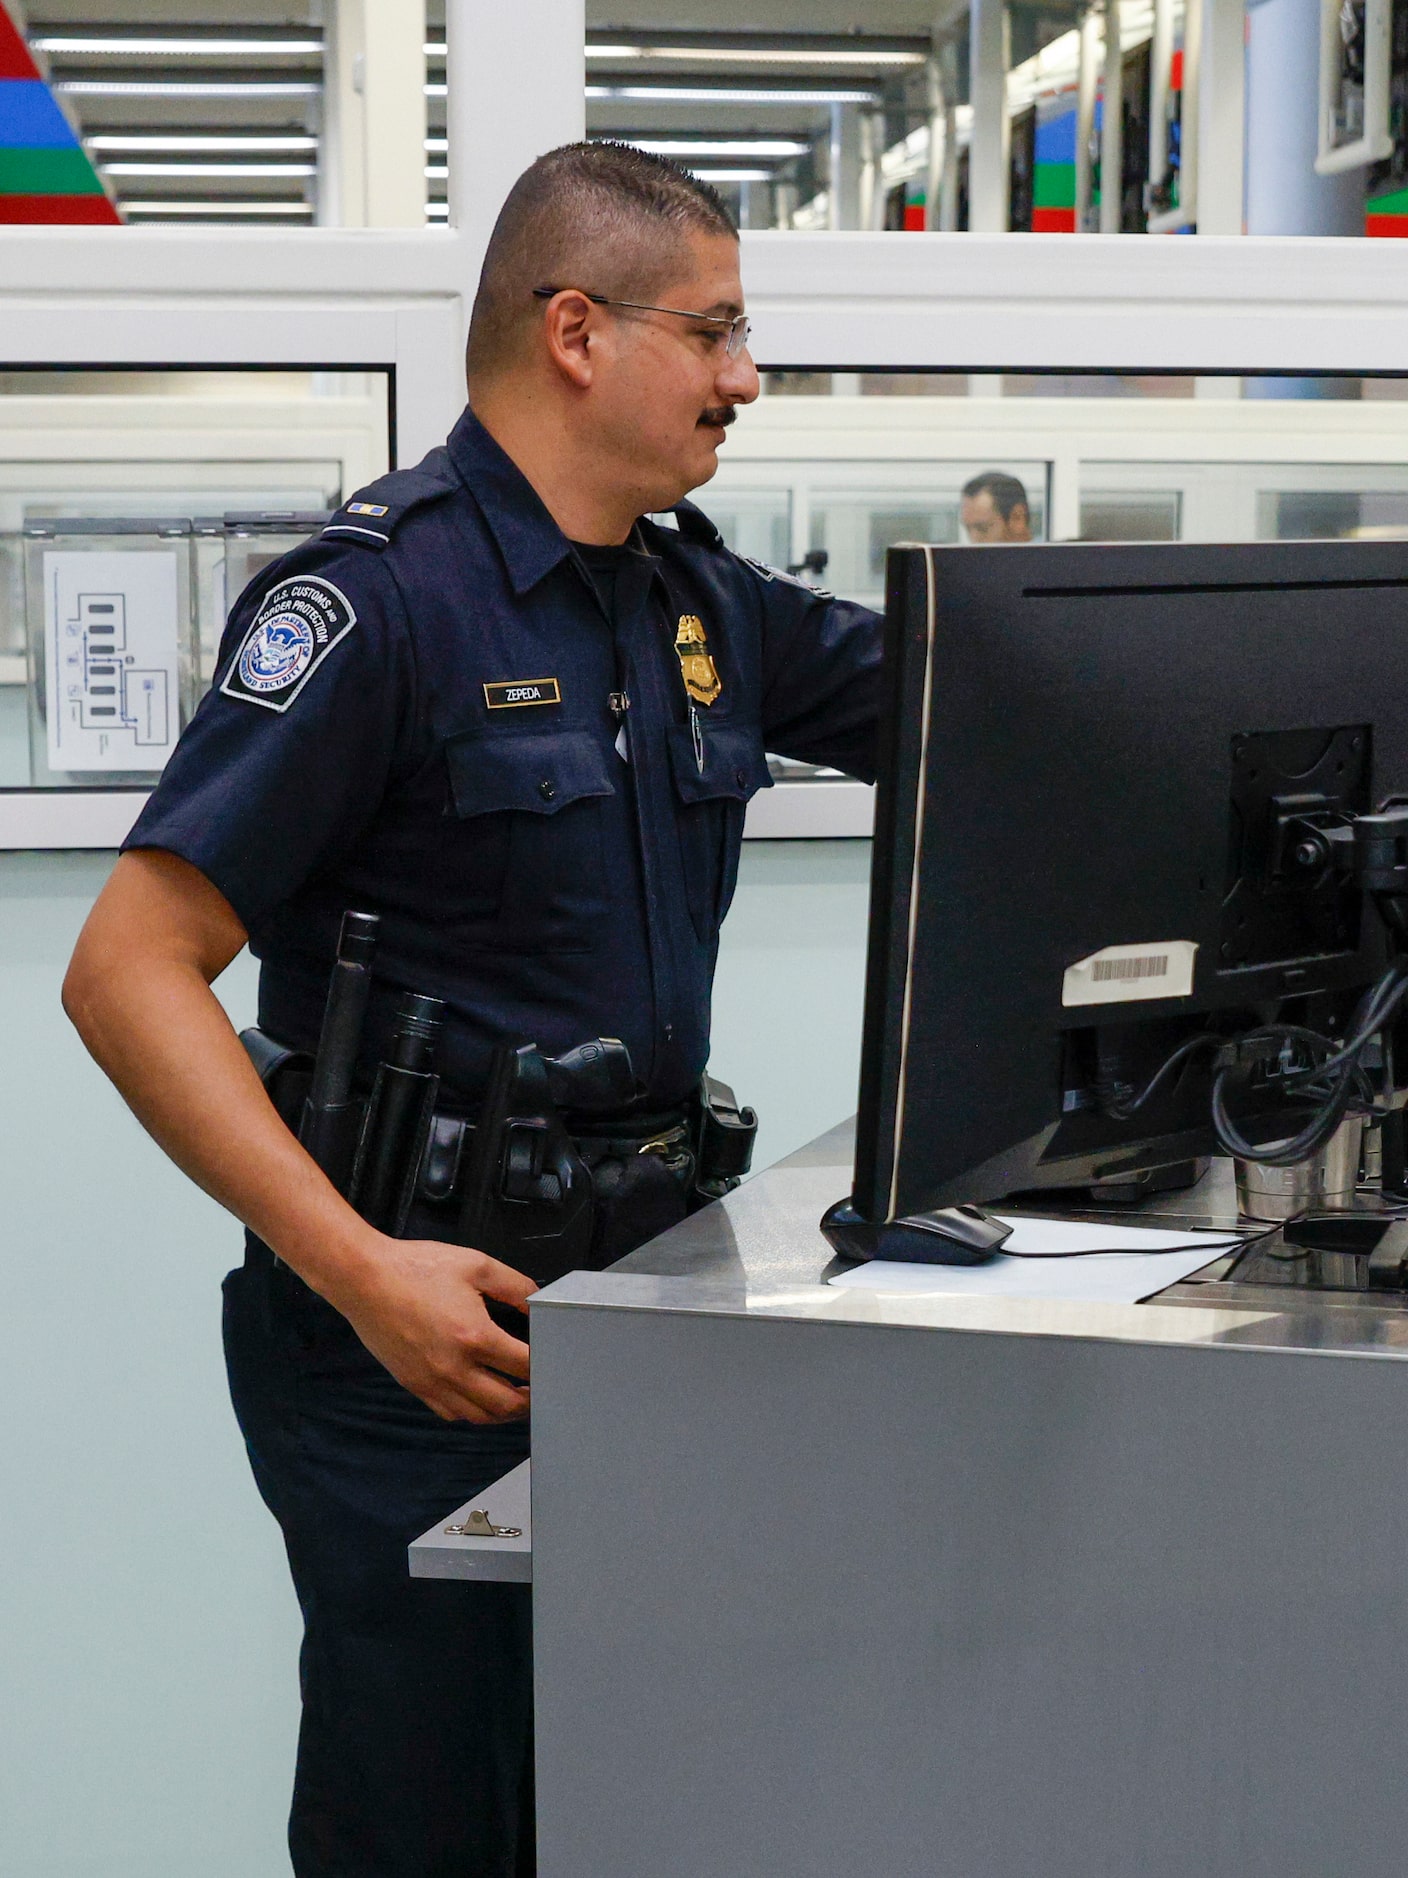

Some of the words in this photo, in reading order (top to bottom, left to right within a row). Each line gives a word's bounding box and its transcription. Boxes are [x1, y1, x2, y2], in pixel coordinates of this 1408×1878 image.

[273, 589, 289, 604] U.S.
[291, 586, 332, 610] CUSTOMS
[325, 608, 338, 623] AND
[258, 600, 292, 625] BORDER
[292, 600, 329, 643] PROTECTION
[259, 664, 301, 689] SECURITY
[506, 687, 541, 701] ZEPEDA
